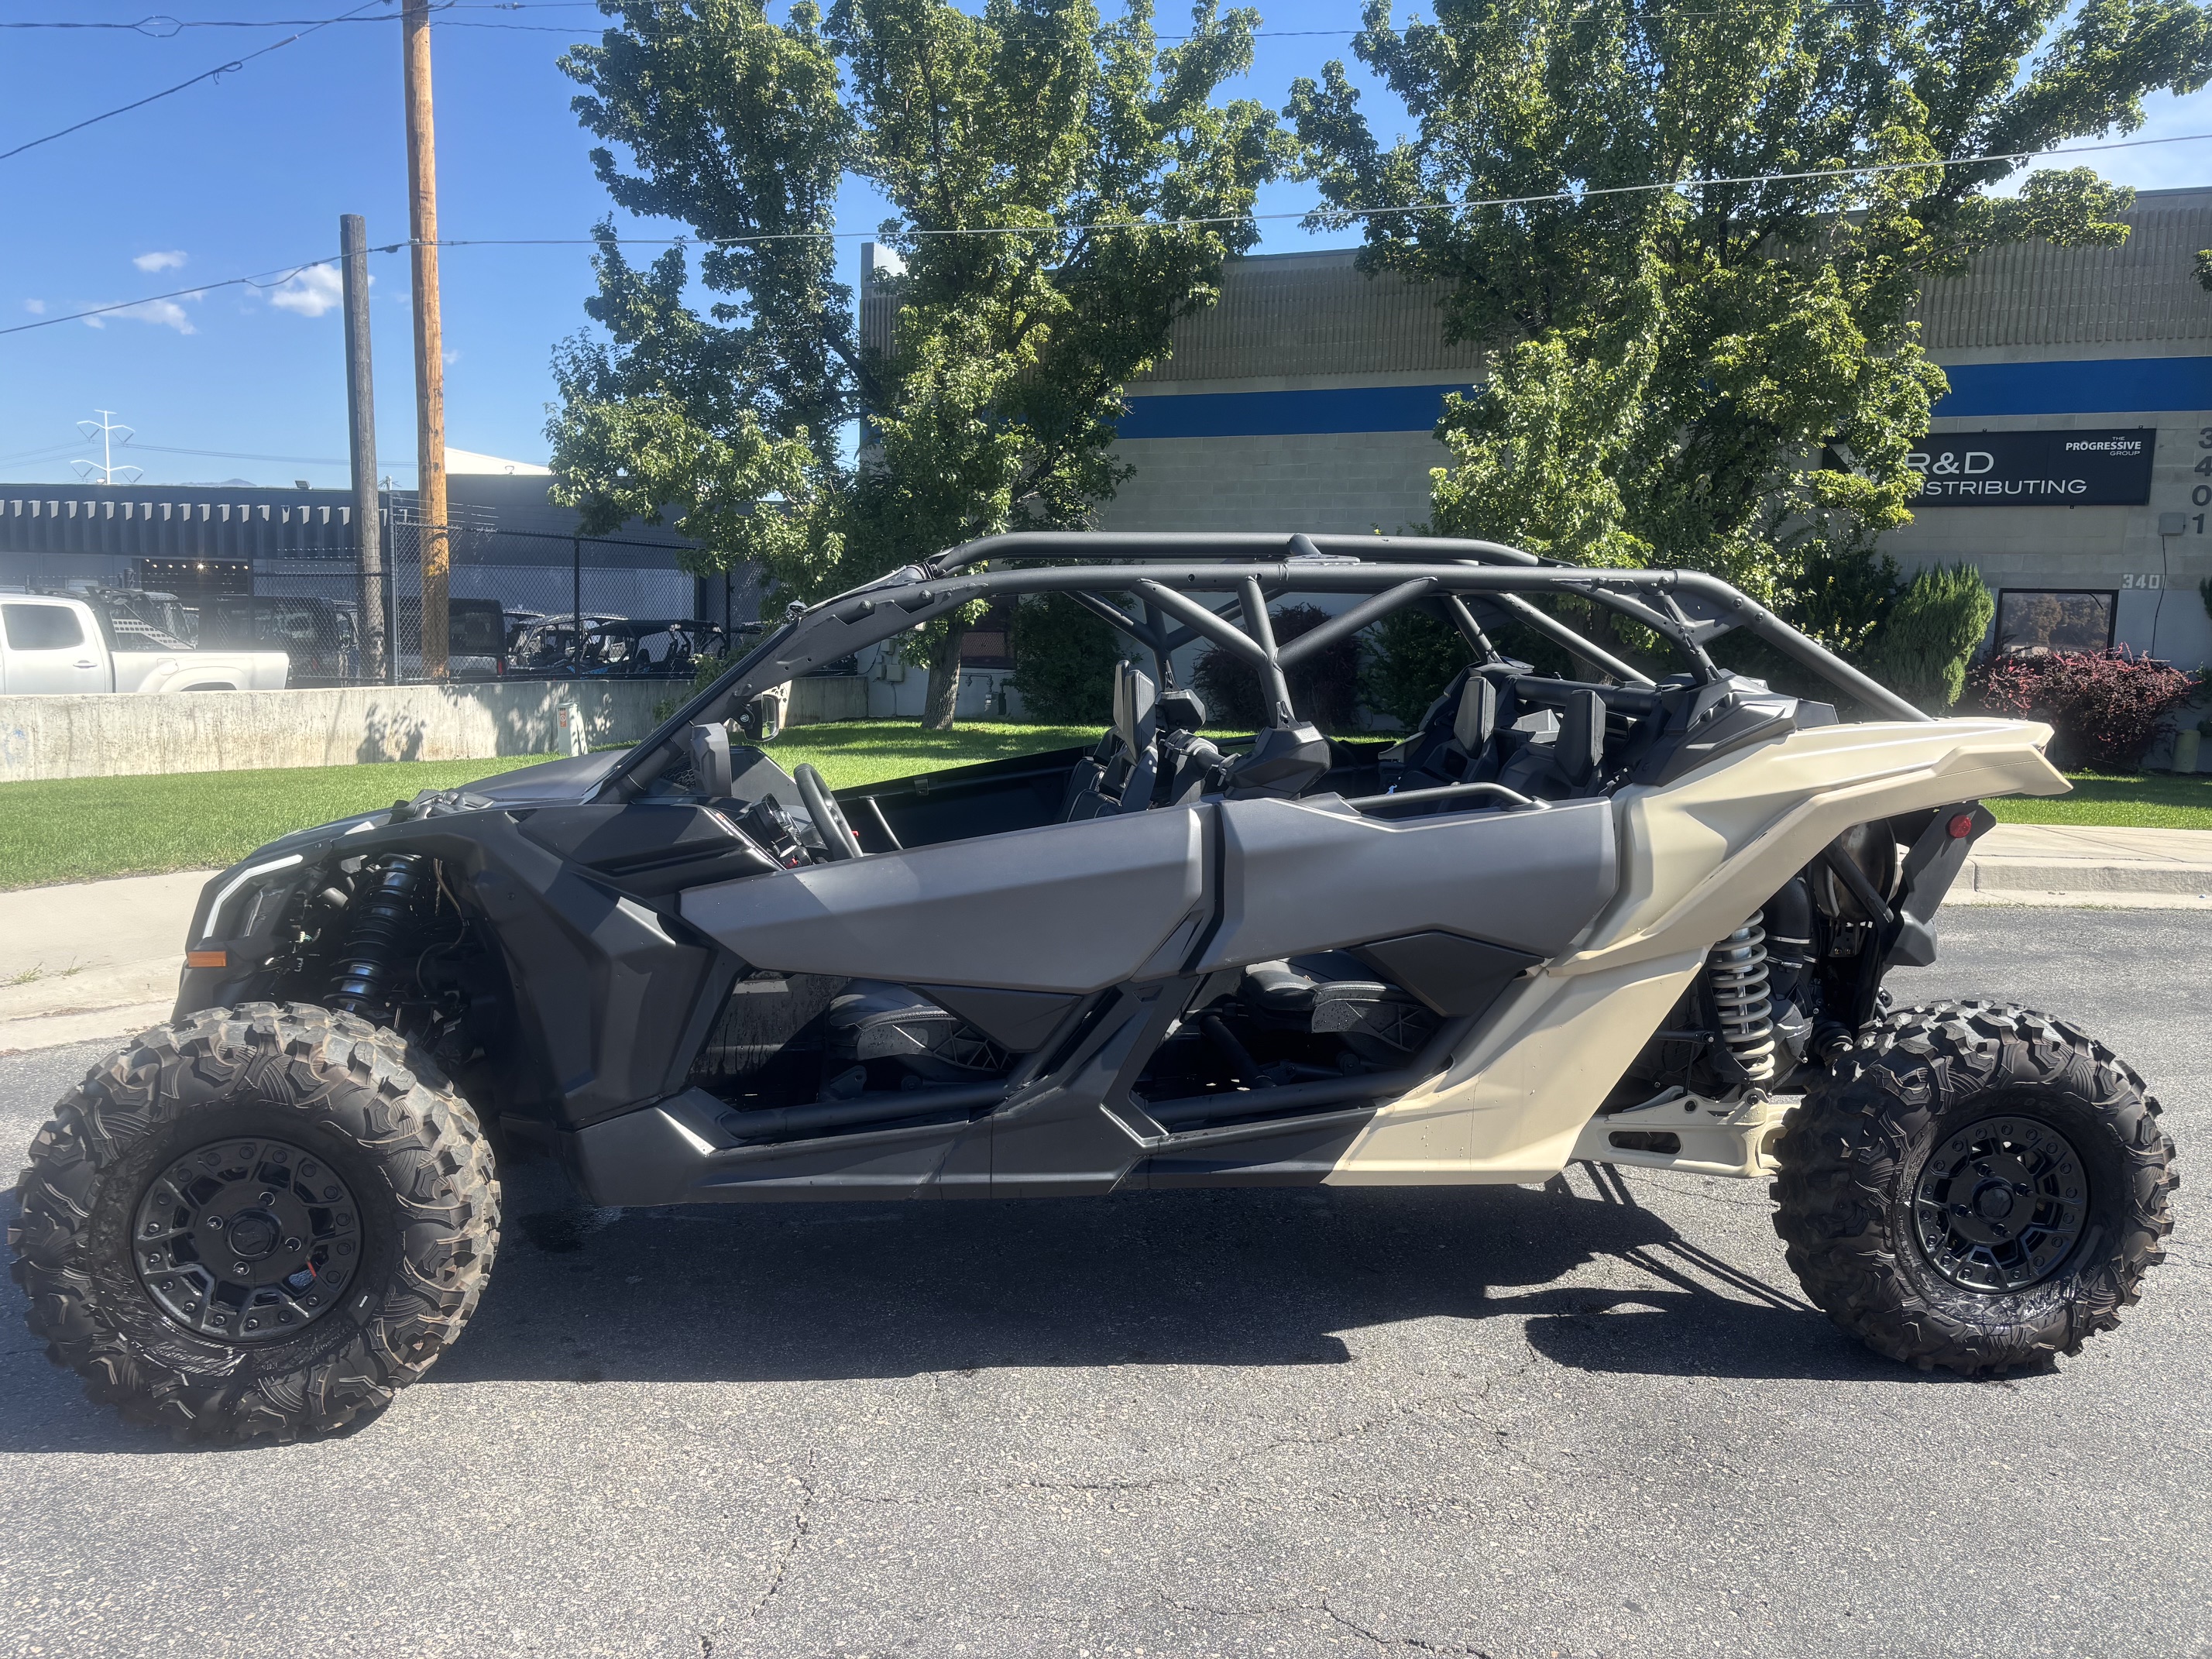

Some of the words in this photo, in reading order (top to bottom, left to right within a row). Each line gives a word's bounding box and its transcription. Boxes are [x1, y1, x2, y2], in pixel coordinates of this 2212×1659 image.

[2066, 441, 2142, 451] PROGRESSIVE
[1905, 452, 1994, 475] R&D
[1919, 479, 2087, 495] ISTRIBUTING
